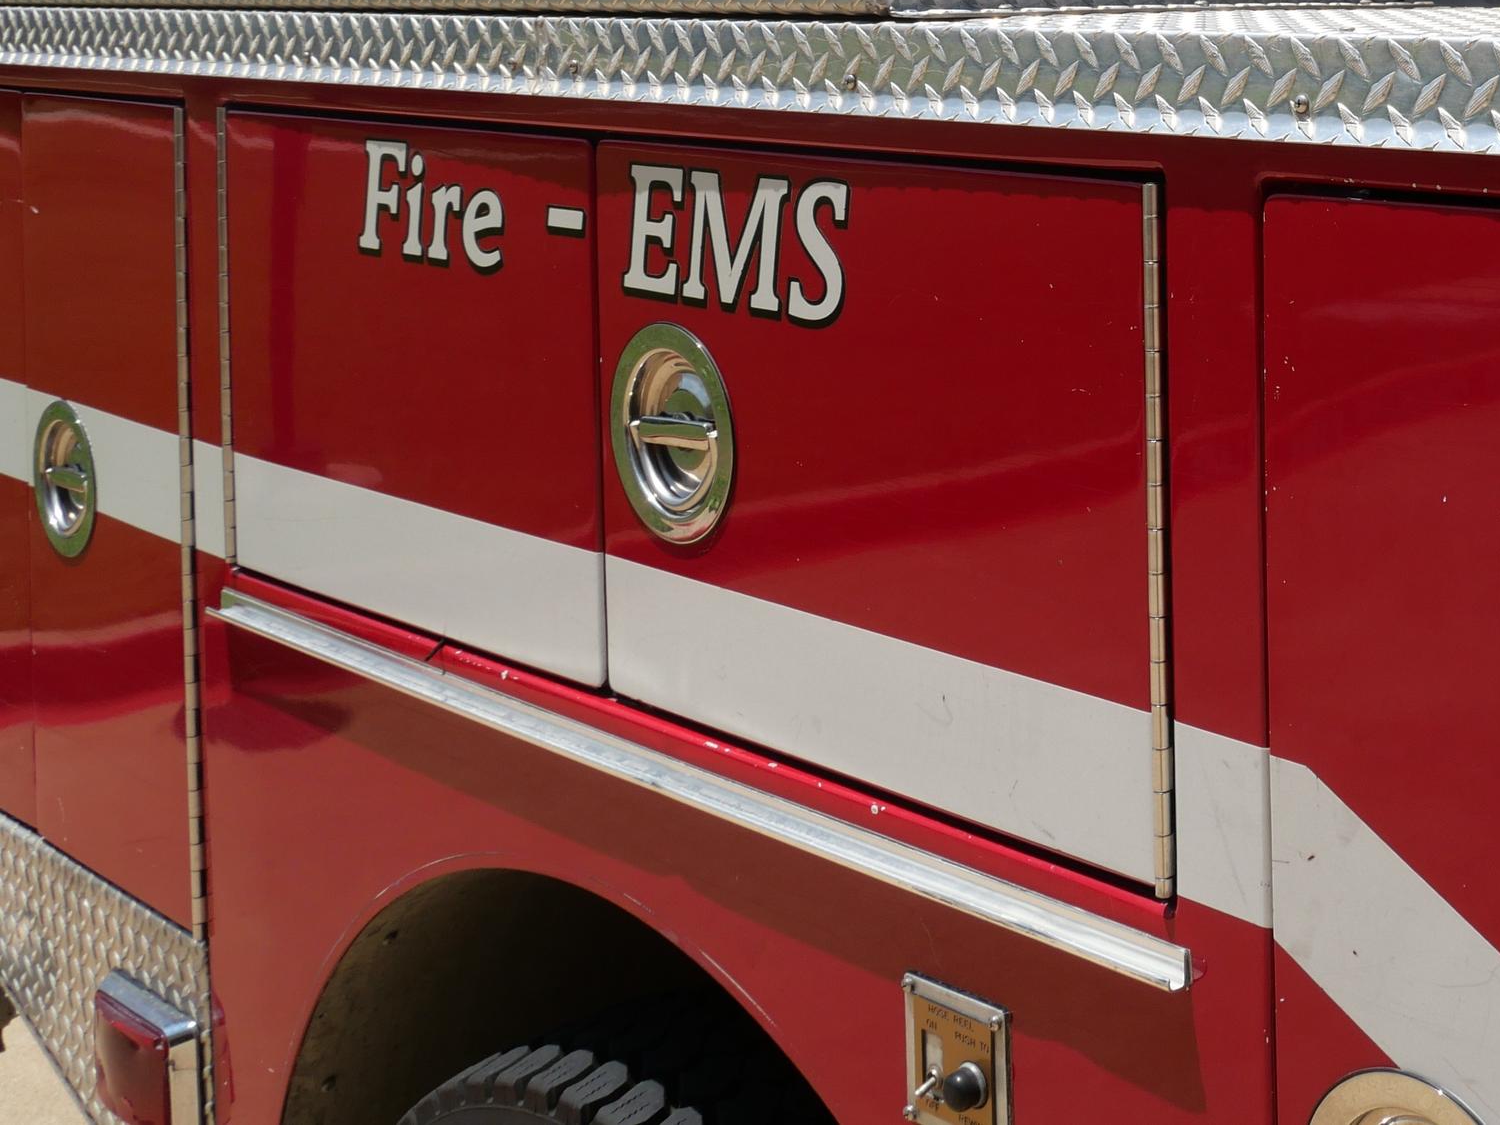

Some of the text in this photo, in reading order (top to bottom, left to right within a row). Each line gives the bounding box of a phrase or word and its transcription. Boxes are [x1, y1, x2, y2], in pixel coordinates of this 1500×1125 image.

[357, 138, 504, 272] Fire
[622, 162, 849, 328] EMS
[955, 1030, 976, 1049] PUSH
